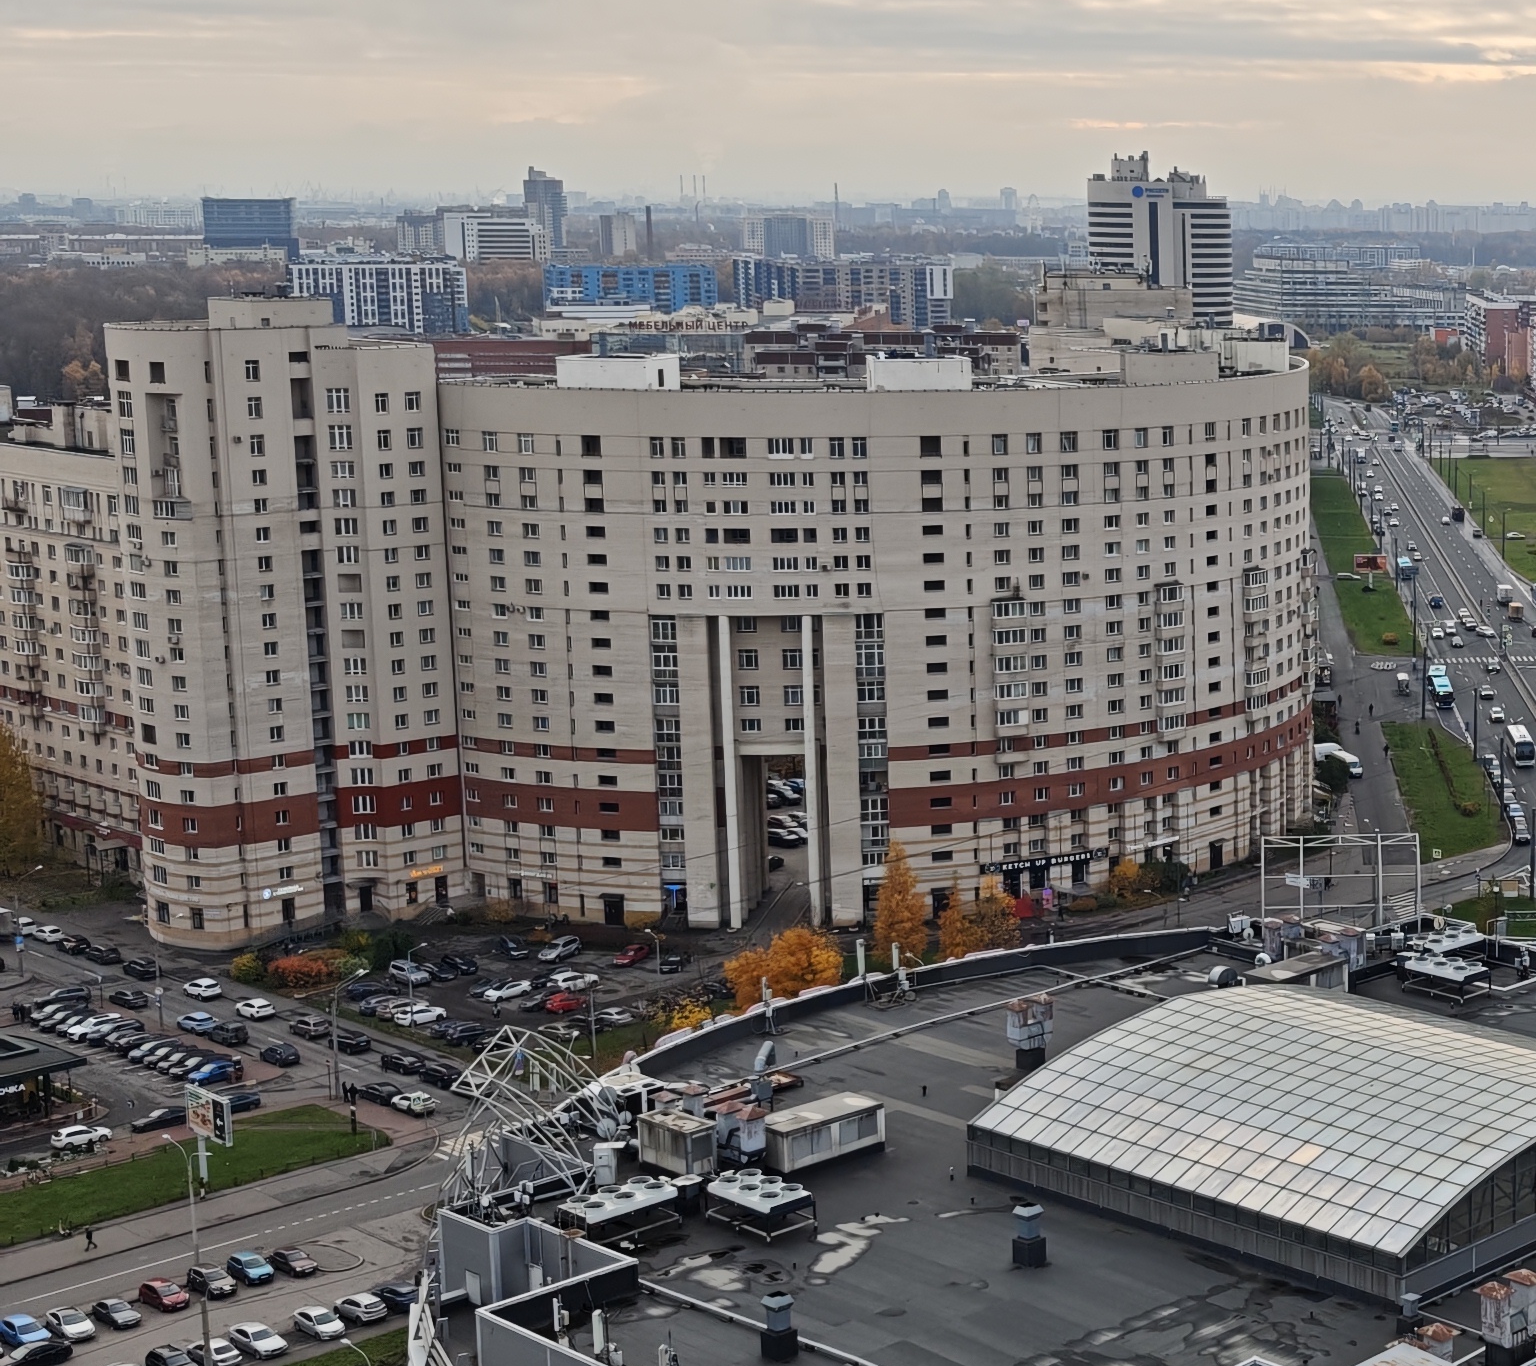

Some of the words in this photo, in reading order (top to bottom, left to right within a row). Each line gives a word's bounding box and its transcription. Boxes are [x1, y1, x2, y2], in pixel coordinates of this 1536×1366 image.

[628, 319, 703, 332] МЕБЕЛЬНЫЙ
[707, 320, 749, 332] ЦЕНТР
[1002, 861, 1031, 871] KETCH
[1035, 858, 1047, 867] UP
